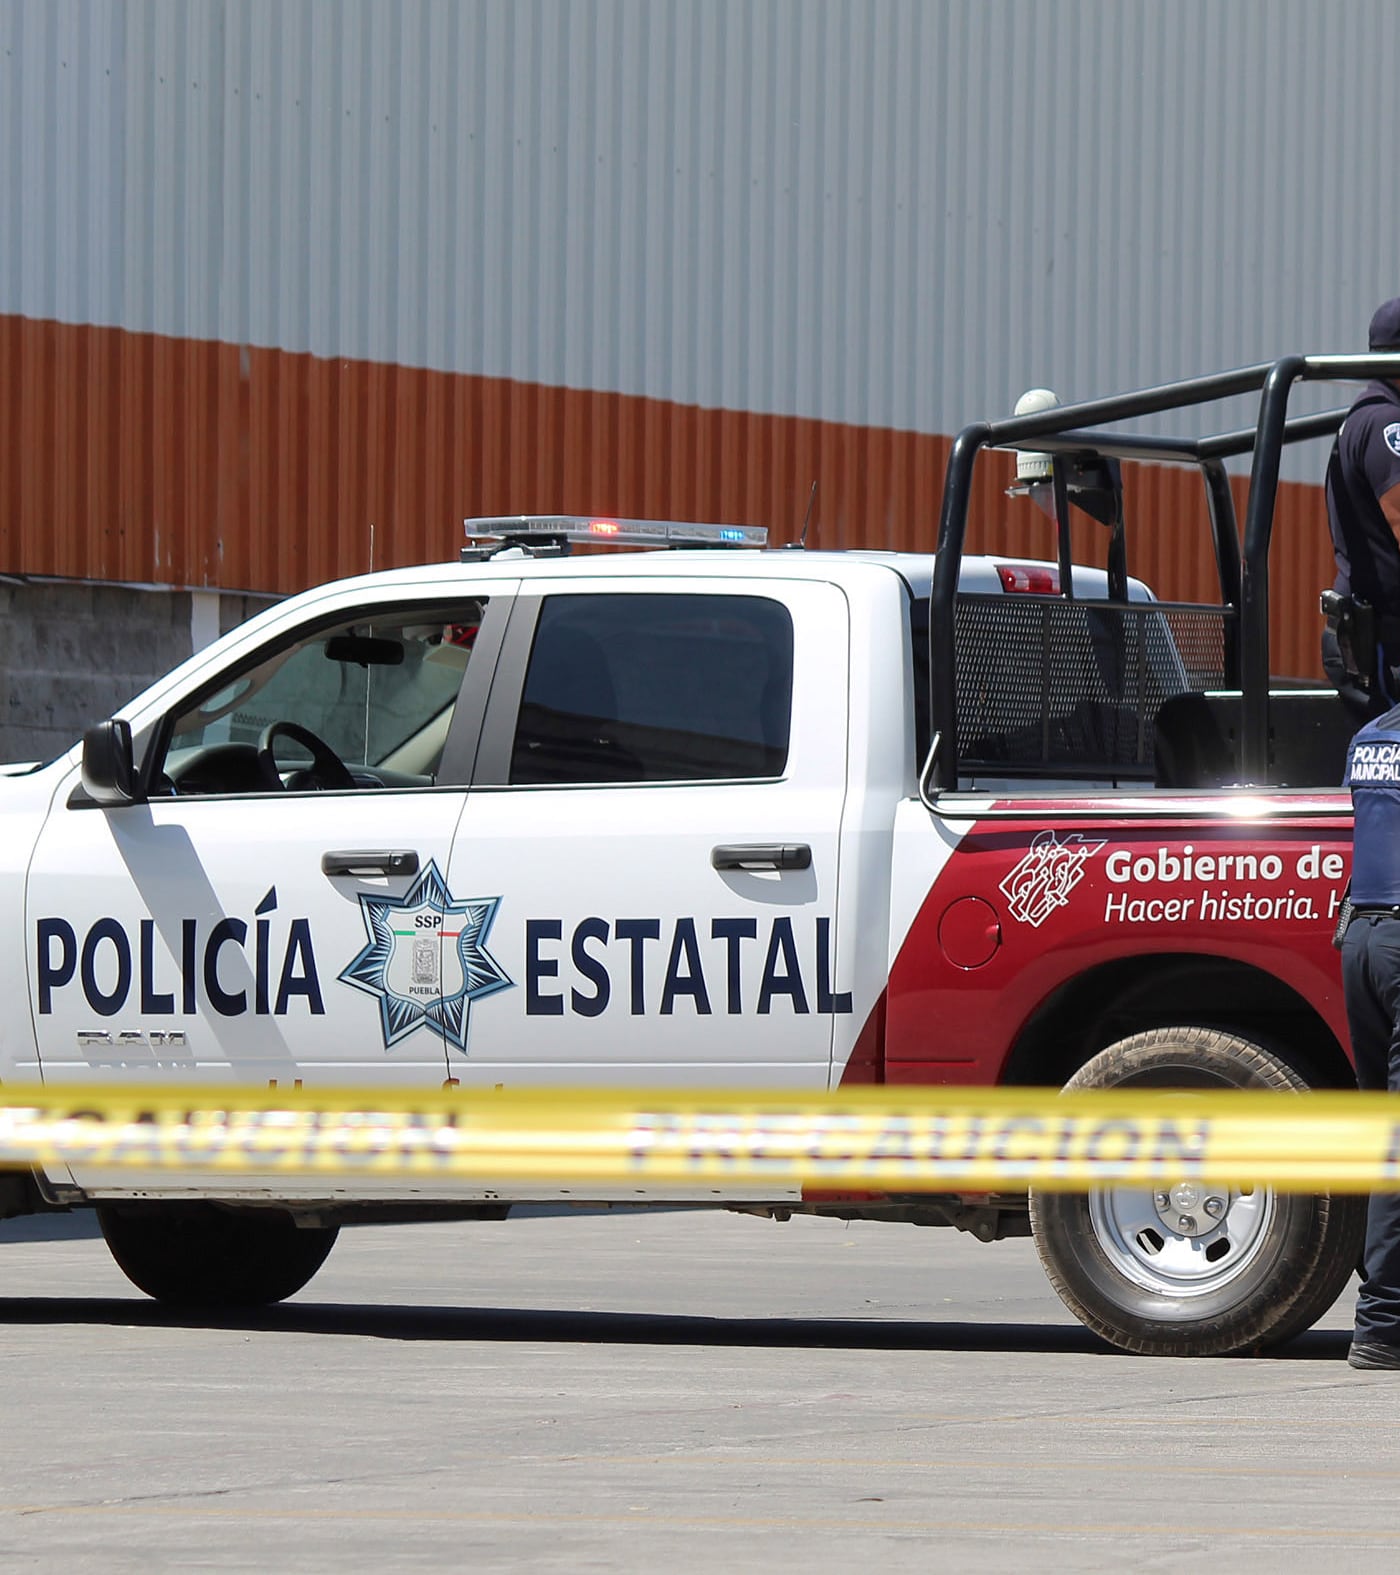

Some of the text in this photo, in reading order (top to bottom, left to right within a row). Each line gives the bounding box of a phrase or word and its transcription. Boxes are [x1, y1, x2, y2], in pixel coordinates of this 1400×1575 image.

[1104, 844, 1345, 883] Gobierno de
[414, 915, 442, 929] SSP
[1103, 892, 1195, 922] Hacer
[1199, 889, 1319, 920] historia.
[34, 885, 327, 1018] POLICÍA
[524, 915, 854, 1016] ESTATAL
[408, 986, 441, 995] PUEBLA
[76, 1029, 187, 1047] RAM
[629, 1110, 1213, 1178] PRECAUCION
